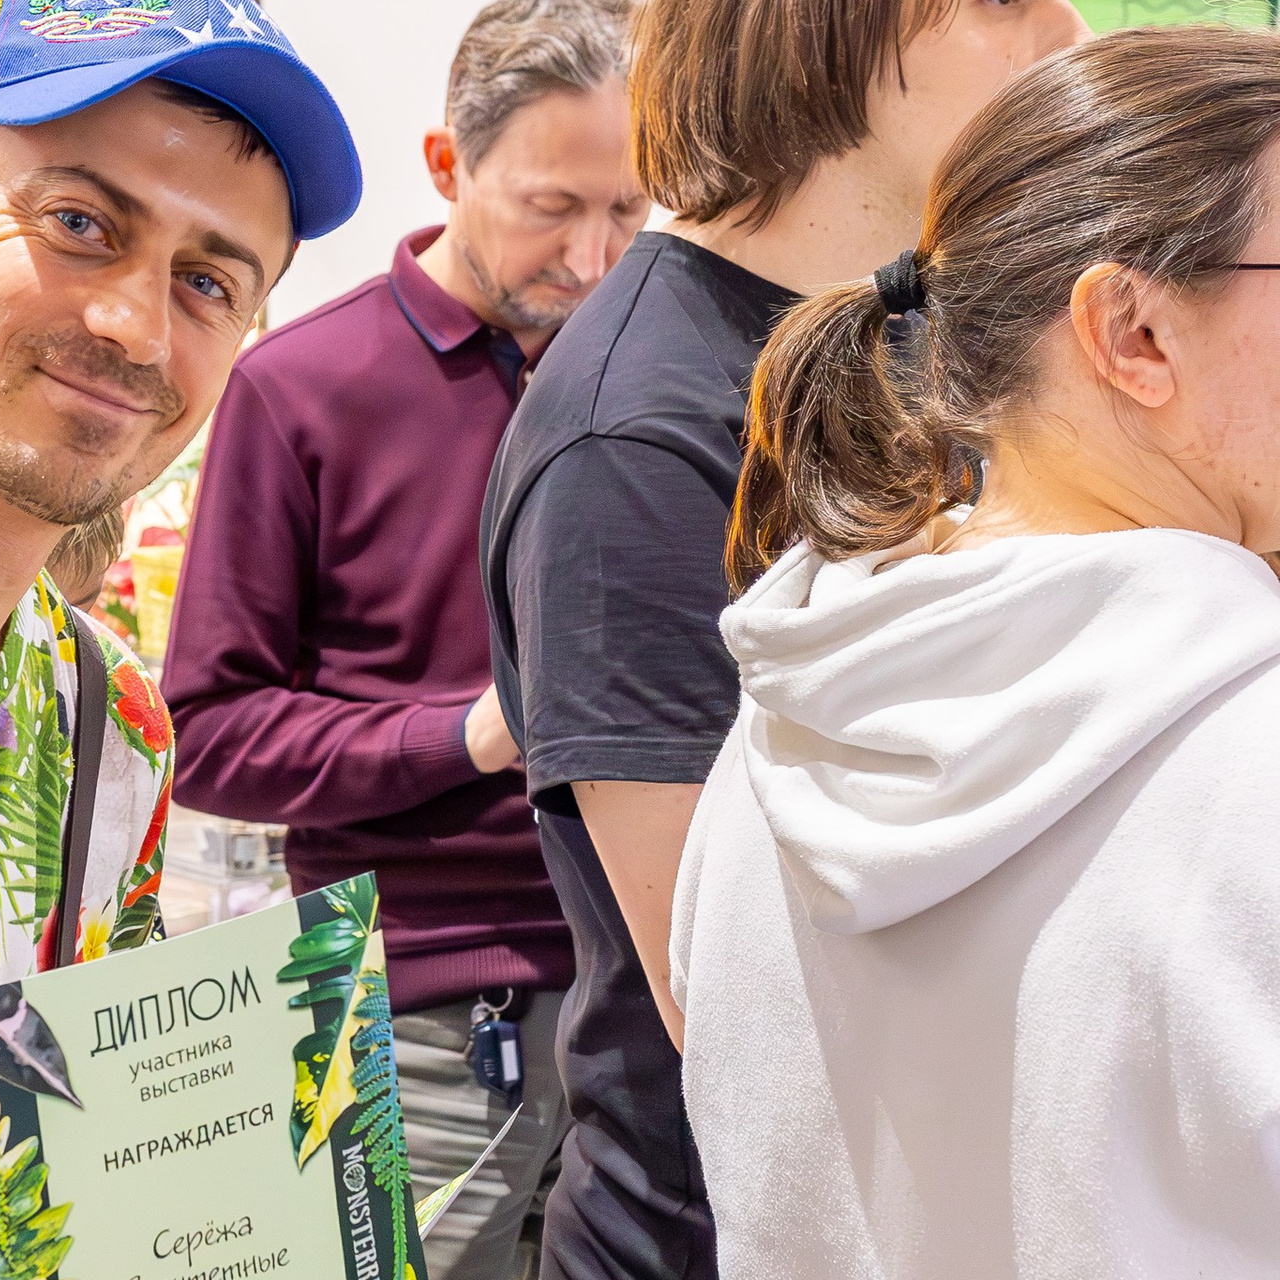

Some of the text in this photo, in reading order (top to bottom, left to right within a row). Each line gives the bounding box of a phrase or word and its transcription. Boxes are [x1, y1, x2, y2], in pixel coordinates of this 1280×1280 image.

[90, 965, 261, 1057] ДИПЛОМ
[129, 1034, 232, 1084] участника
[140, 1061, 234, 1102] выставки
[104, 1103, 274, 1172] НАГРАЖДАЕТСЯ
[153, 1215, 253, 1267] Серёжа
